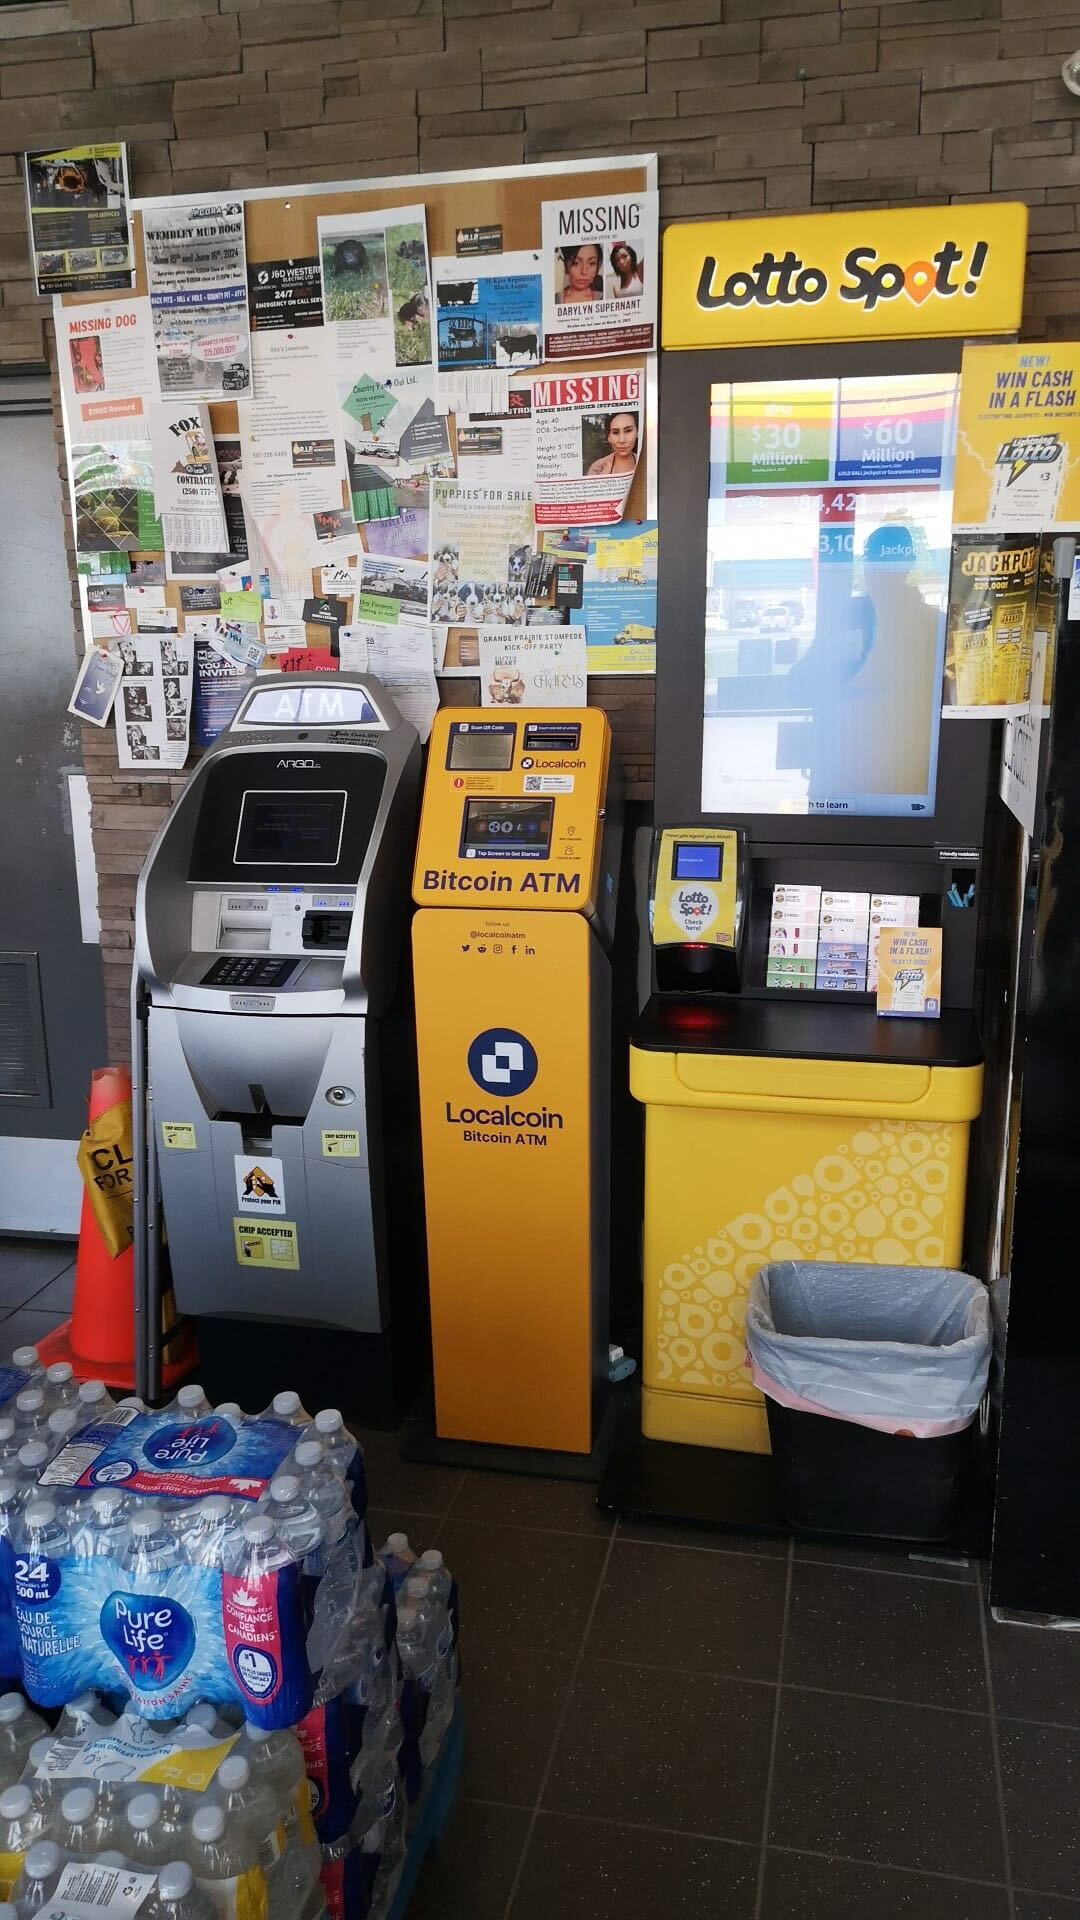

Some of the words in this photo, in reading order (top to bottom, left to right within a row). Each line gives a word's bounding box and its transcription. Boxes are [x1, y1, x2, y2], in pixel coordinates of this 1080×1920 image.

[559, 204, 640, 235] MISSING
[147, 229, 194, 240] WEMBLEY
[196, 226, 216, 237] MUD
[218, 222, 241, 234] BOGS
[154, 255, 168, 265] June
[182, 253, 193, 262] and
[195, 252, 210, 263] June
[224, 248, 238, 259] 2024
[696, 251, 828, 310] Lotto
[838, 240, 989, 310] Spot!
[274, 290, 293, 299] 24/7
[255, 300, 287, 309] EMERGENCY
[557, 304, 593, 317] DARYLYN
[595, 299, 641, 314] SUPERNANT
[69, 317, 111, 334] MISSING
[116, 314, 137, 328] DOG
[352, 383, 375, 394] Country
[406, 376, 418, 385] Ltd.
[996, 372, 1028, 389] WIN
[1031, 370, 1074, 388] CASH
[535, 374, 639, 406] MISSING
[988, 391, 1007, 409] IN
[1009, 391, 1023, 408] A
[1025, 390, 1077, 407] FLASH
[109, 404, 136, 414] Reward
[169, 417, 201, 436] FOX
[553, 425, 581, 433] December
[862, 418, 914, 446] $60
[751, 421, 801, 450] $30
[536, 445, 556, 453] Height:
[862, 447, 916, 463] Million
[435, 489, 479, 500] PUPPIES
[483, 490, 503, 500] FOR
[507, 491, 533, 501] SALE
[401, 513, 417, 523] LOSE
[965, 550, 1036, 572] JACKPOT
[483, 635, 512, 643] GRANDE
[199, 668, 245, 677] INVITED
[274, 692, 345, 719] ATM
[276, 759, 315, 769] ARGO
[535, 758, 586, 769] Localcoin
[825, 800, 849, 809] learn
[423, 869, 513, 892] Bitcoin
[519, 872, 581, 894] ATM
[678, 891, 709, 903] Lotto
[679, 903, 713, 917] Spot!
[470, 930, 526, 940] @localcoinatm
[892, 938, 907, 946] WIN
[908, 938, 929, 947] CASH
[889, 947, 898, 955] IN
[899, 947, 904, 955] A
[446, 1101, 564, 1129] Localcoin
[463, 1130, 512, 1144] Bitcoin
[515, 1133, 547, 1146] ATM
[241, 1196, 260, 1204] Protect
[239, 1225, 255, 1235] CHIP
[256, 1226, 293, 1238] ACCEPTED
[170, 1435, 210, 1450] Life
[154, 1448, 209, 1464] Pure
[14, 1559, 49, 1582] 24
[35, 1589, 51, 1599] mL
[35, 1611, 52, 1625] DE
[115, 1598, 173, 1630] Pure
[226, 1604, 273, 1624] CONFIANCE
[227, 1623, 275, 1643] CANADIENS
[239, 1620, 256, 1633] DES
[21, 1634, 82, 1657] NATURELLE
[123, 1624, 165, 1653] Life
